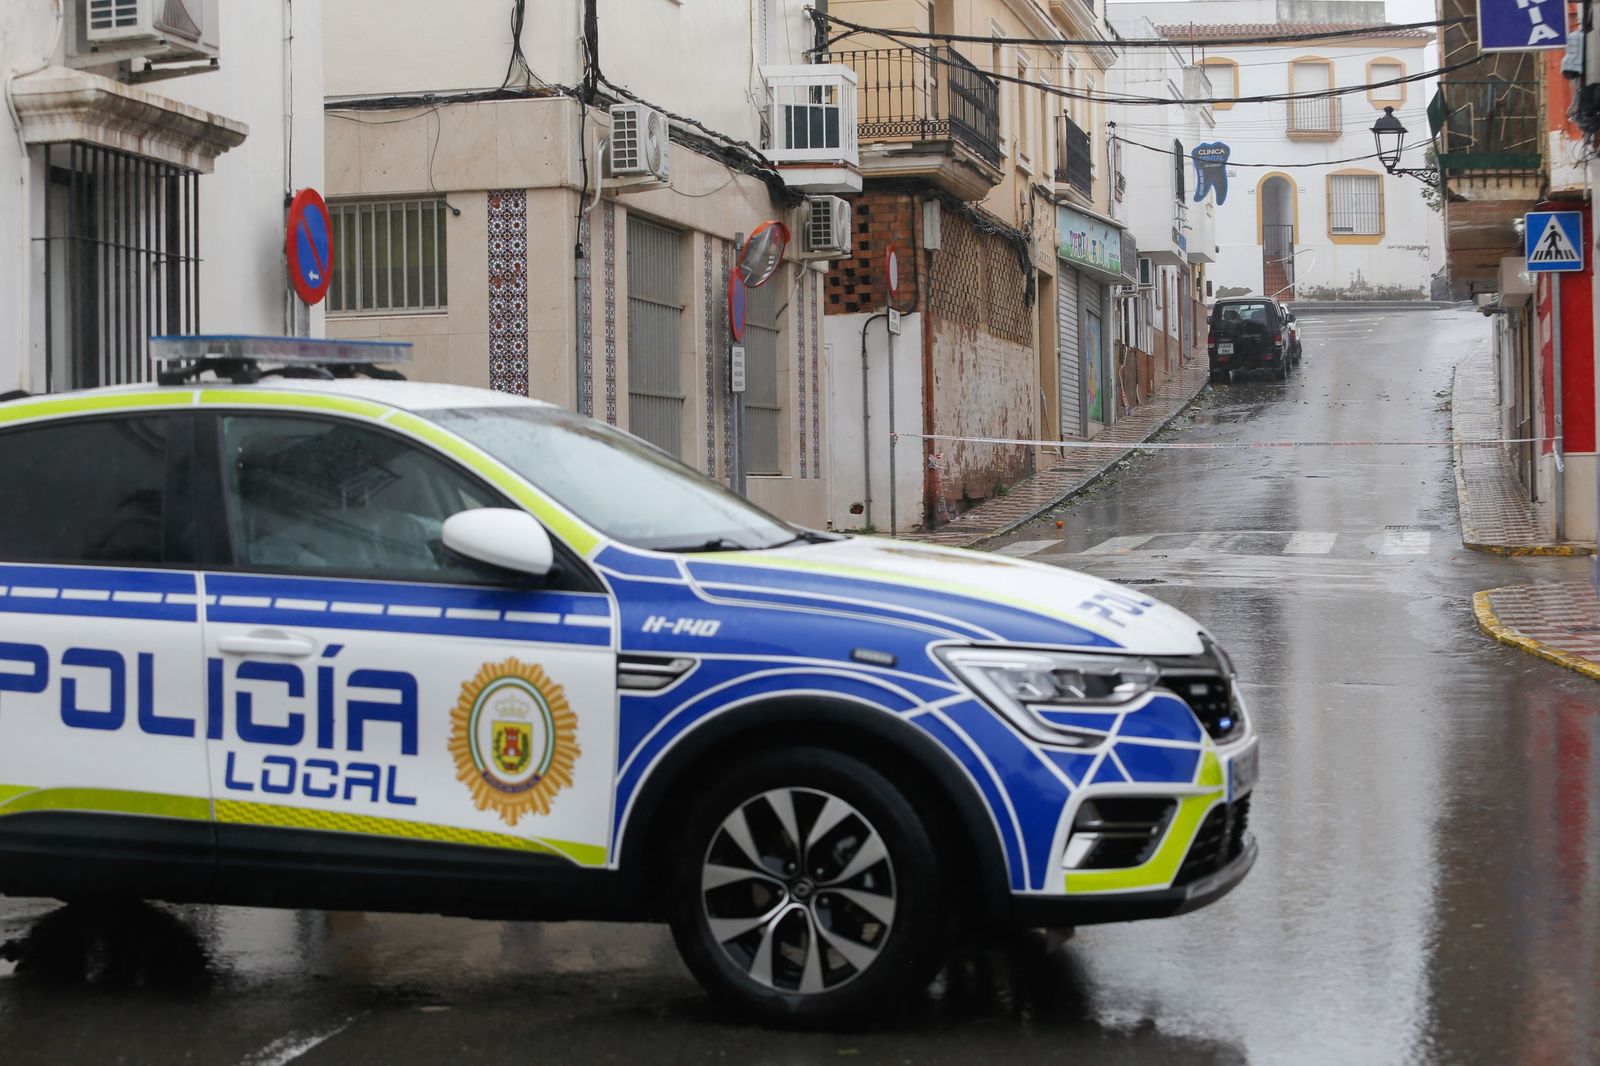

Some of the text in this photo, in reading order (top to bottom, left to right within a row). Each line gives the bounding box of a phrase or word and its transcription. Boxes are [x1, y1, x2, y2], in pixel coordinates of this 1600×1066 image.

[1515, 0, 1560, 45] IA
[641, 615, 721, 637] H-140
[0, 642, 418, 756] POLICÍA
[225, 751, 417, 806] LOCAL
